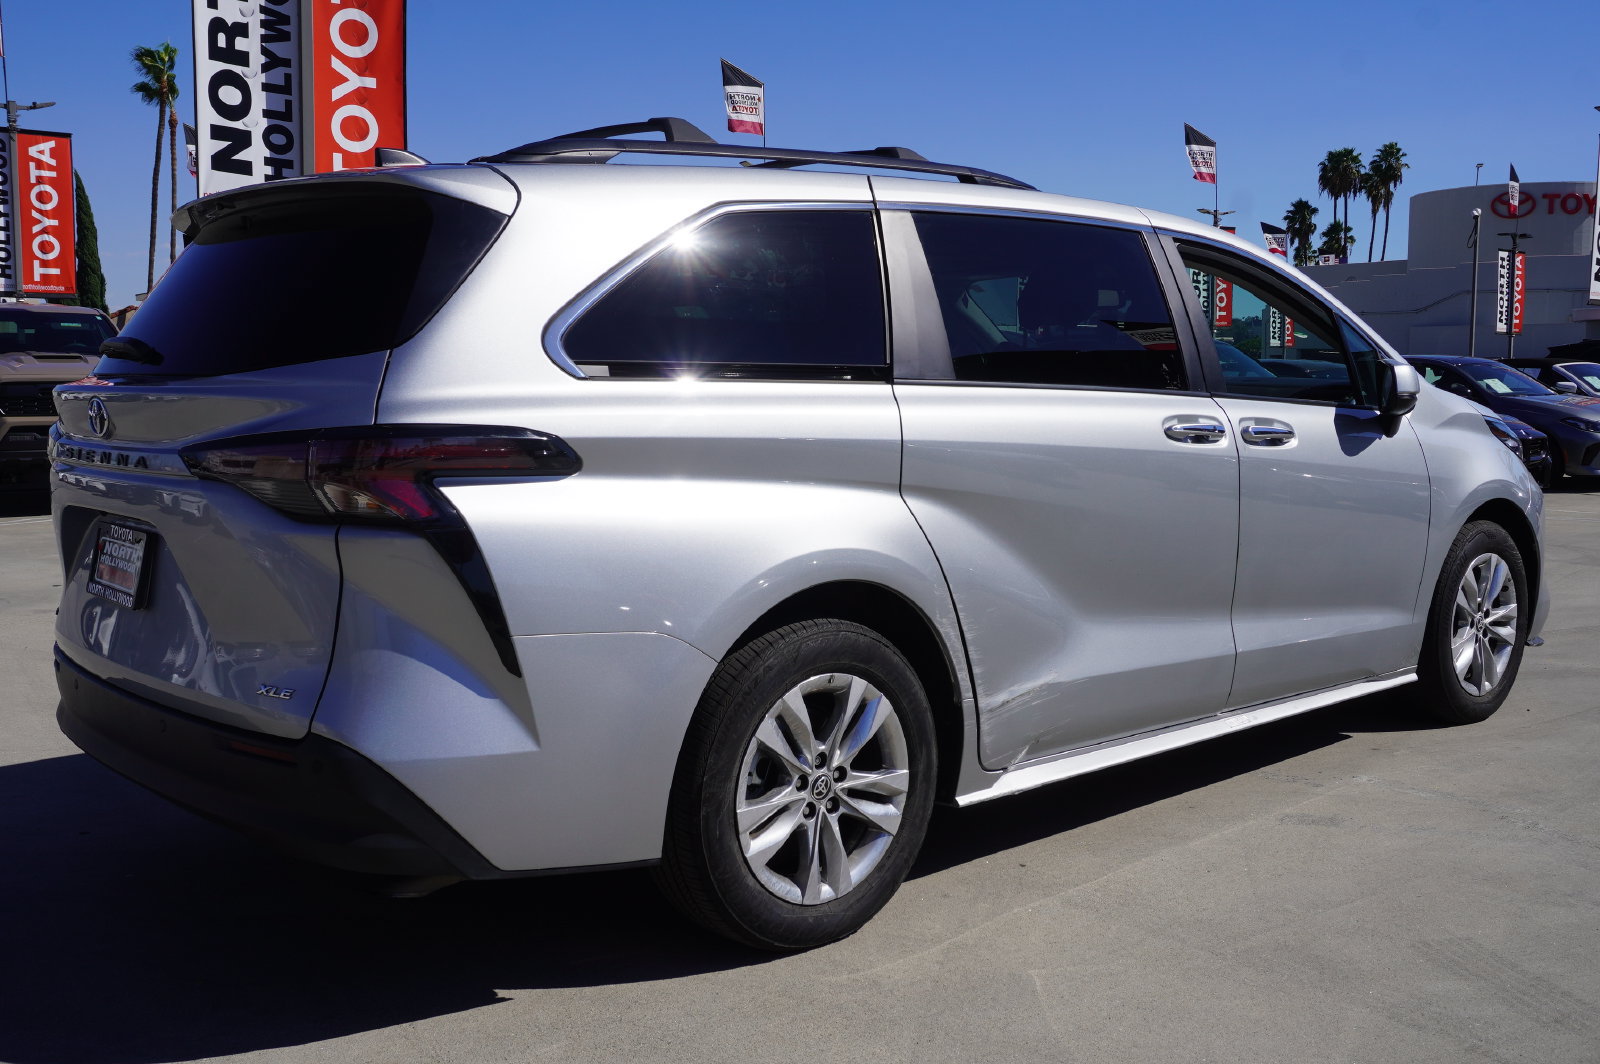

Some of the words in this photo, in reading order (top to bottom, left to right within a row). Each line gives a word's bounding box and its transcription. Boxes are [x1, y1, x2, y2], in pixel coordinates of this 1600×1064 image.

[207, 0, 253, 177] NOR
[259, 0, 294, 182] HOLLYW
[329, 0, 379, 172] OYO
[28, 140, 61, 282] TOYOTA
[1216, 277, 1227, 320] TOY
[1513, 255, 1523, 325] TOYOTA
[66, 447, 149, 469] SIENNA
[103, 541, 139, 563] NORTH
[111, 524, 133, 542] TOYOTA
[88, 582, 104, 598] NORTH
[105, 588, 133, 608] HOLLYWOOD
[256, 684, 296, 700] XLE
